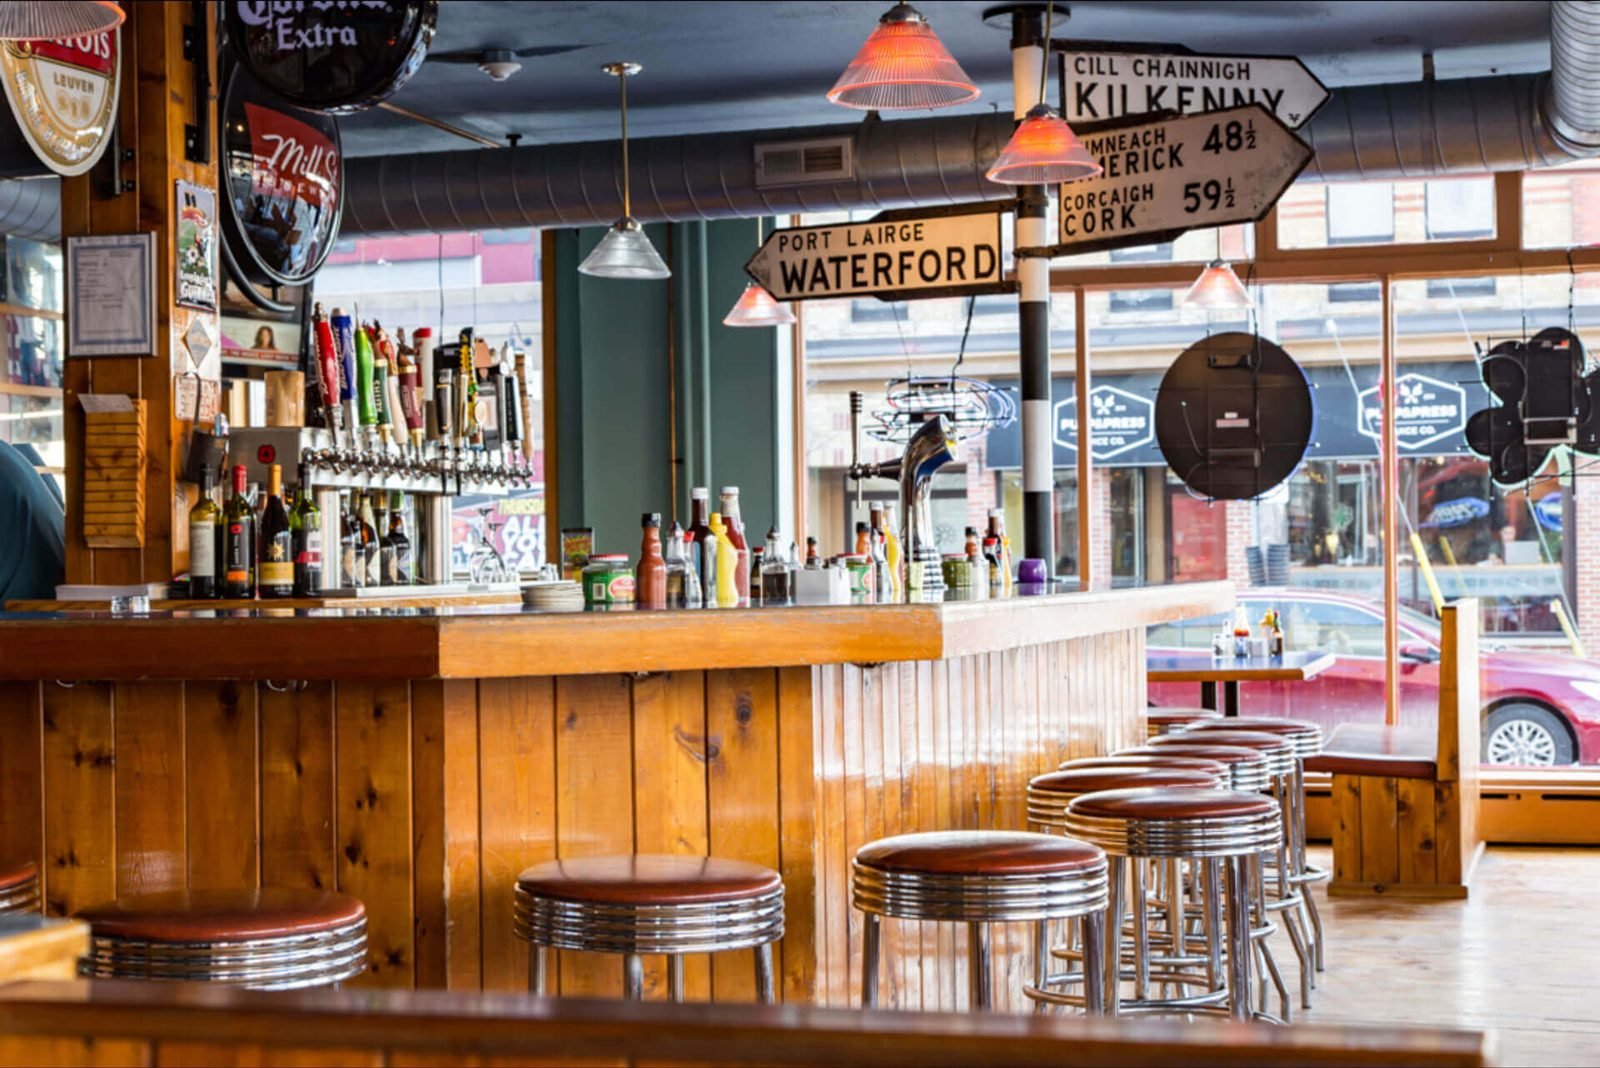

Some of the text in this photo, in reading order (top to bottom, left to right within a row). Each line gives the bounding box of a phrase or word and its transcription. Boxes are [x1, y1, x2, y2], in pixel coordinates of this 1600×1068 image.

[276, 17, 358, 50] Extra
[1074, 57, 1250, 80] CILL CHAINNIGH
[261, 134, 324, 175] Mill
[1064, 183, 1154, 212] CORCAIGH
[1064, 204, 1137, 236] CORK
[779, 223, 924, 253] PORT LAIRGE
[780, 244, 997, 294] WATERFORD
